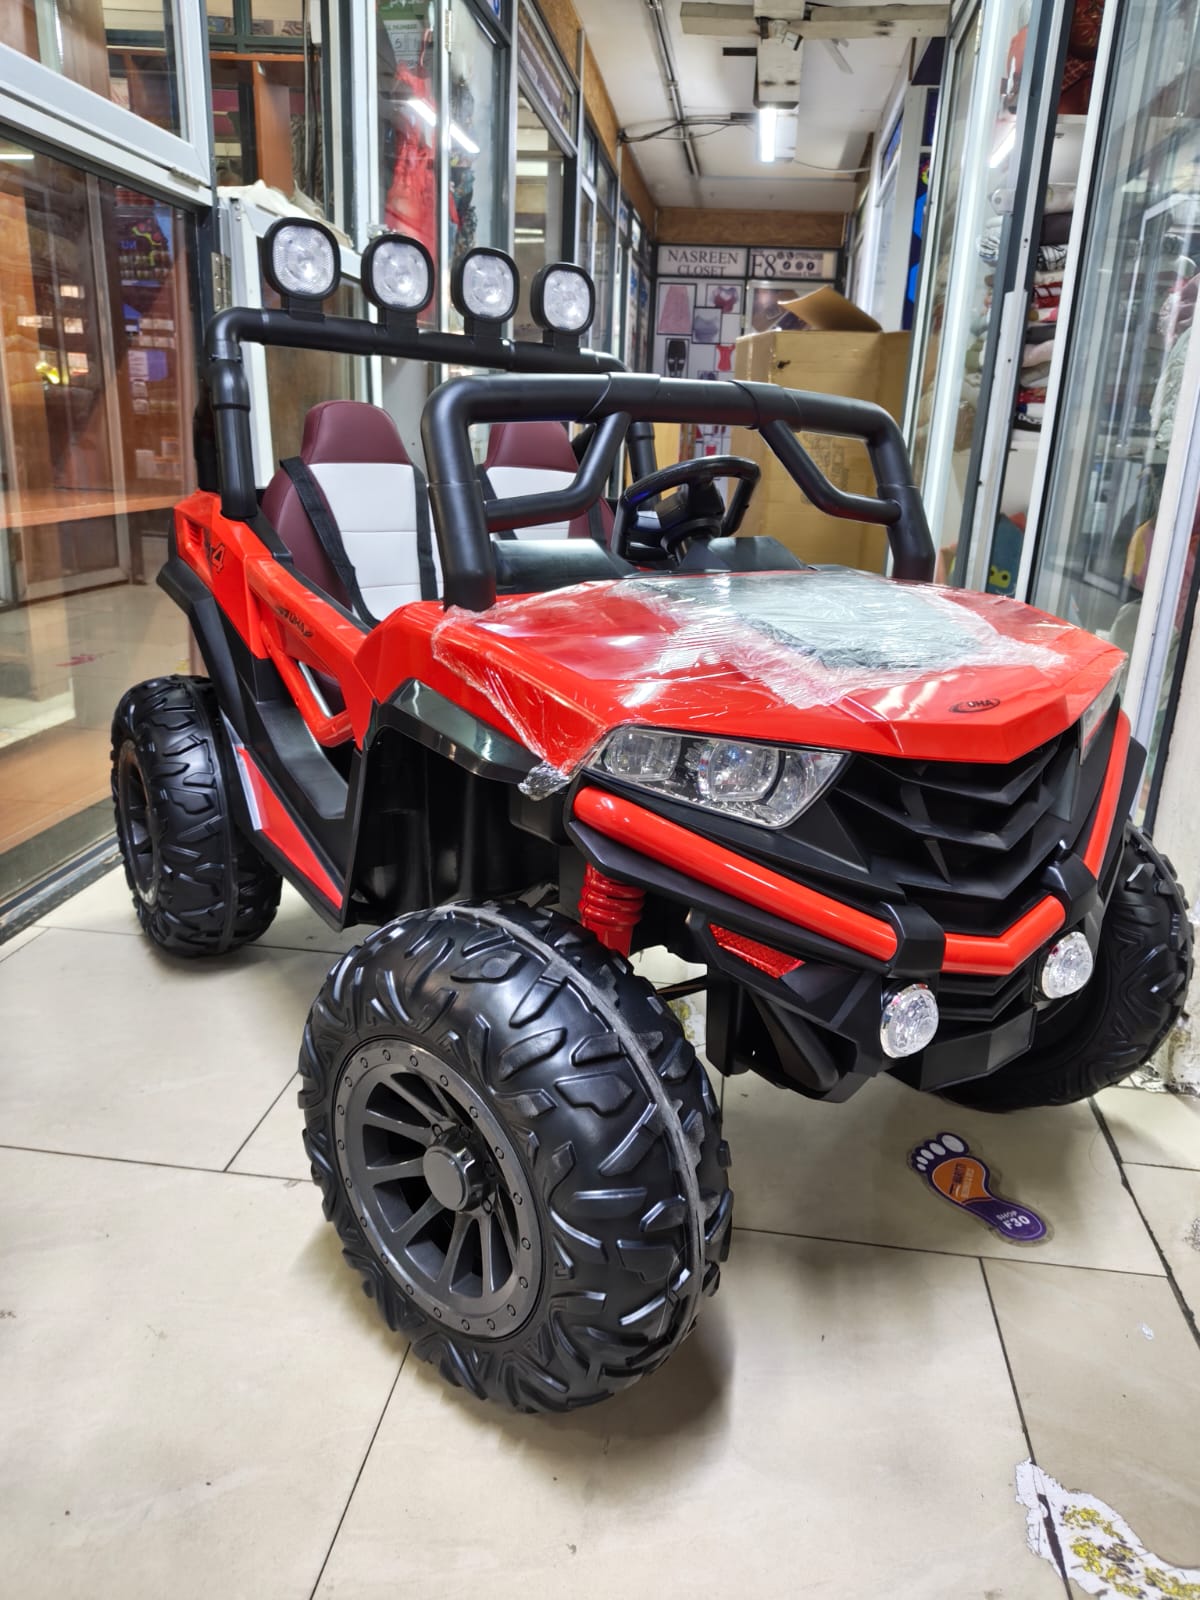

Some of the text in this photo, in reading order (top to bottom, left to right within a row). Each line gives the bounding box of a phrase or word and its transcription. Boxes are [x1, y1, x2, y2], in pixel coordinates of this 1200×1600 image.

[668, 249, 740, 265] NASREEN
[677, 264, 727, 277] CLOSET
[751, 253, 777, 278] F8
[1002, 1215, 1030, 1230] F30
